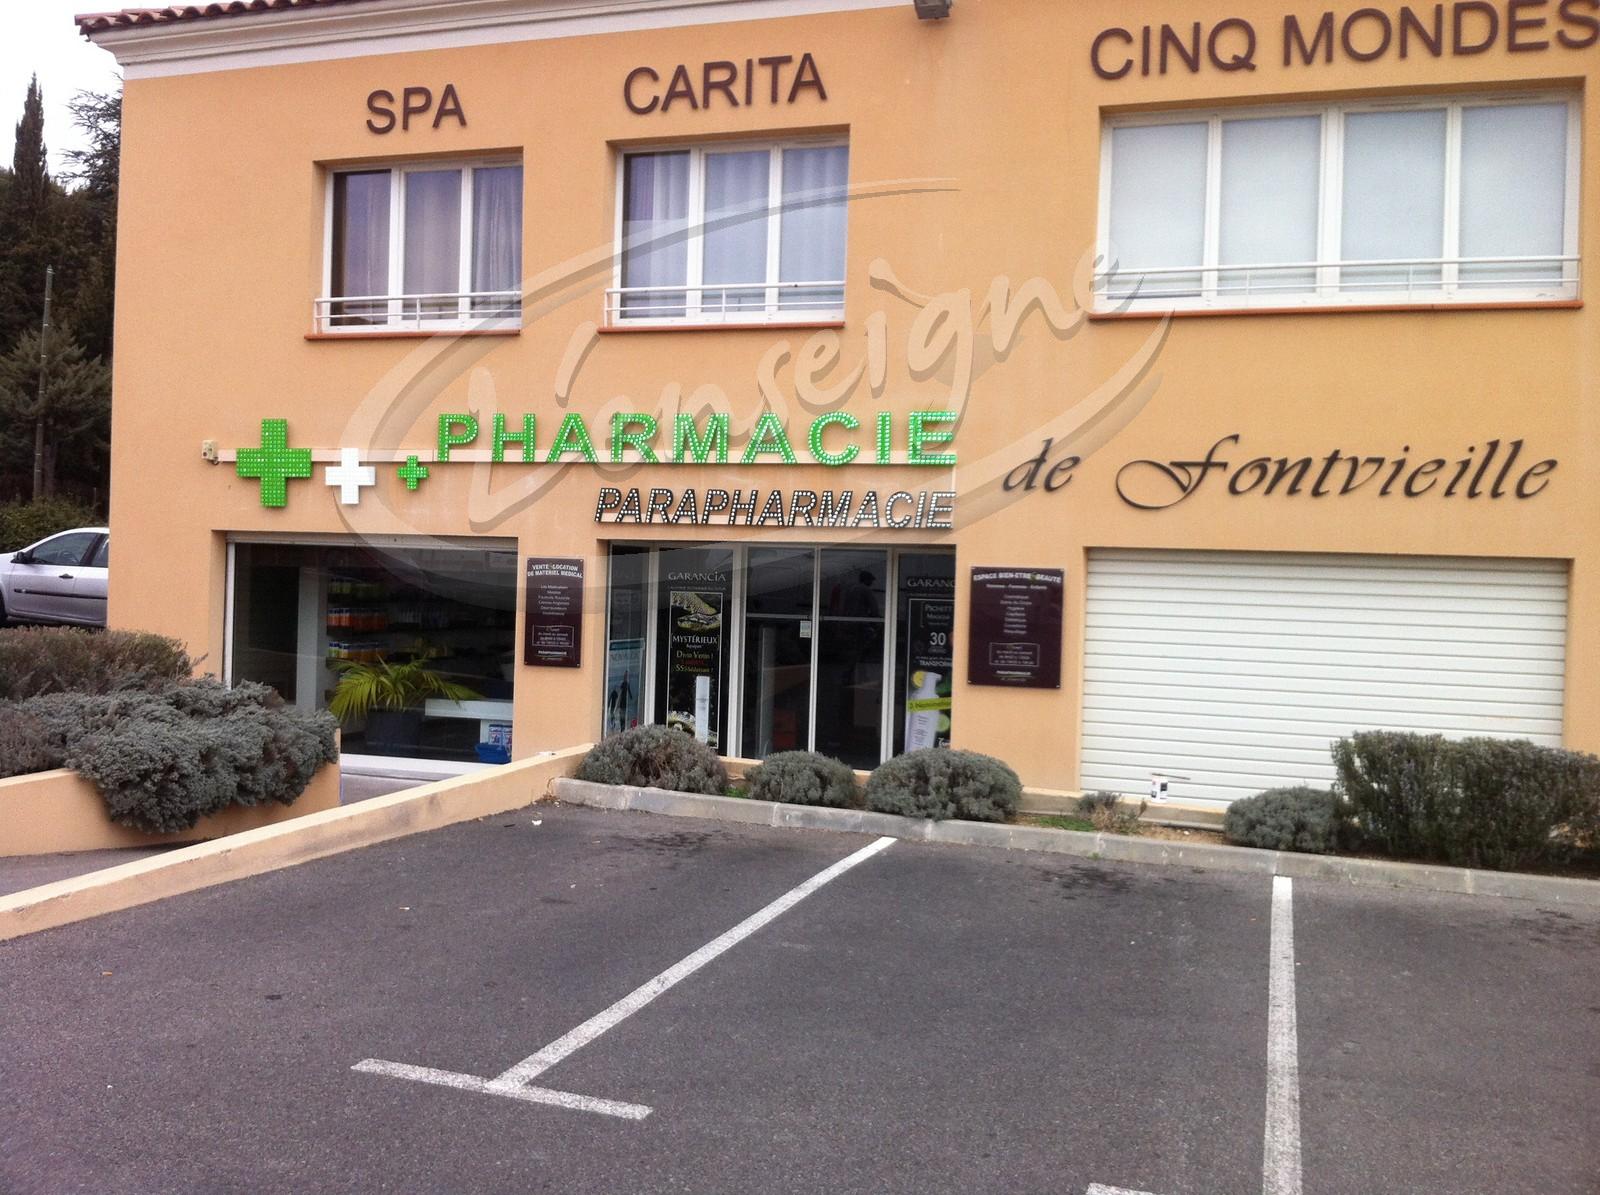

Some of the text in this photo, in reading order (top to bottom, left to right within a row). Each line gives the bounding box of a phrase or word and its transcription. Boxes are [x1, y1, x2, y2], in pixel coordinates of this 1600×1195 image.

[1090, 0, 1600, 81] CINQ MONDES
[367, 84, 467, 135] SPA
[624, 53, 827, 115] CARITA
[438, 411, 957, 466] PHARMACIE
[1003, 433, 1559, 511] de Fontvieille
[594, 487, 956, 531] PARAPHARMACIE
[929, 632, 947, 646] 30
